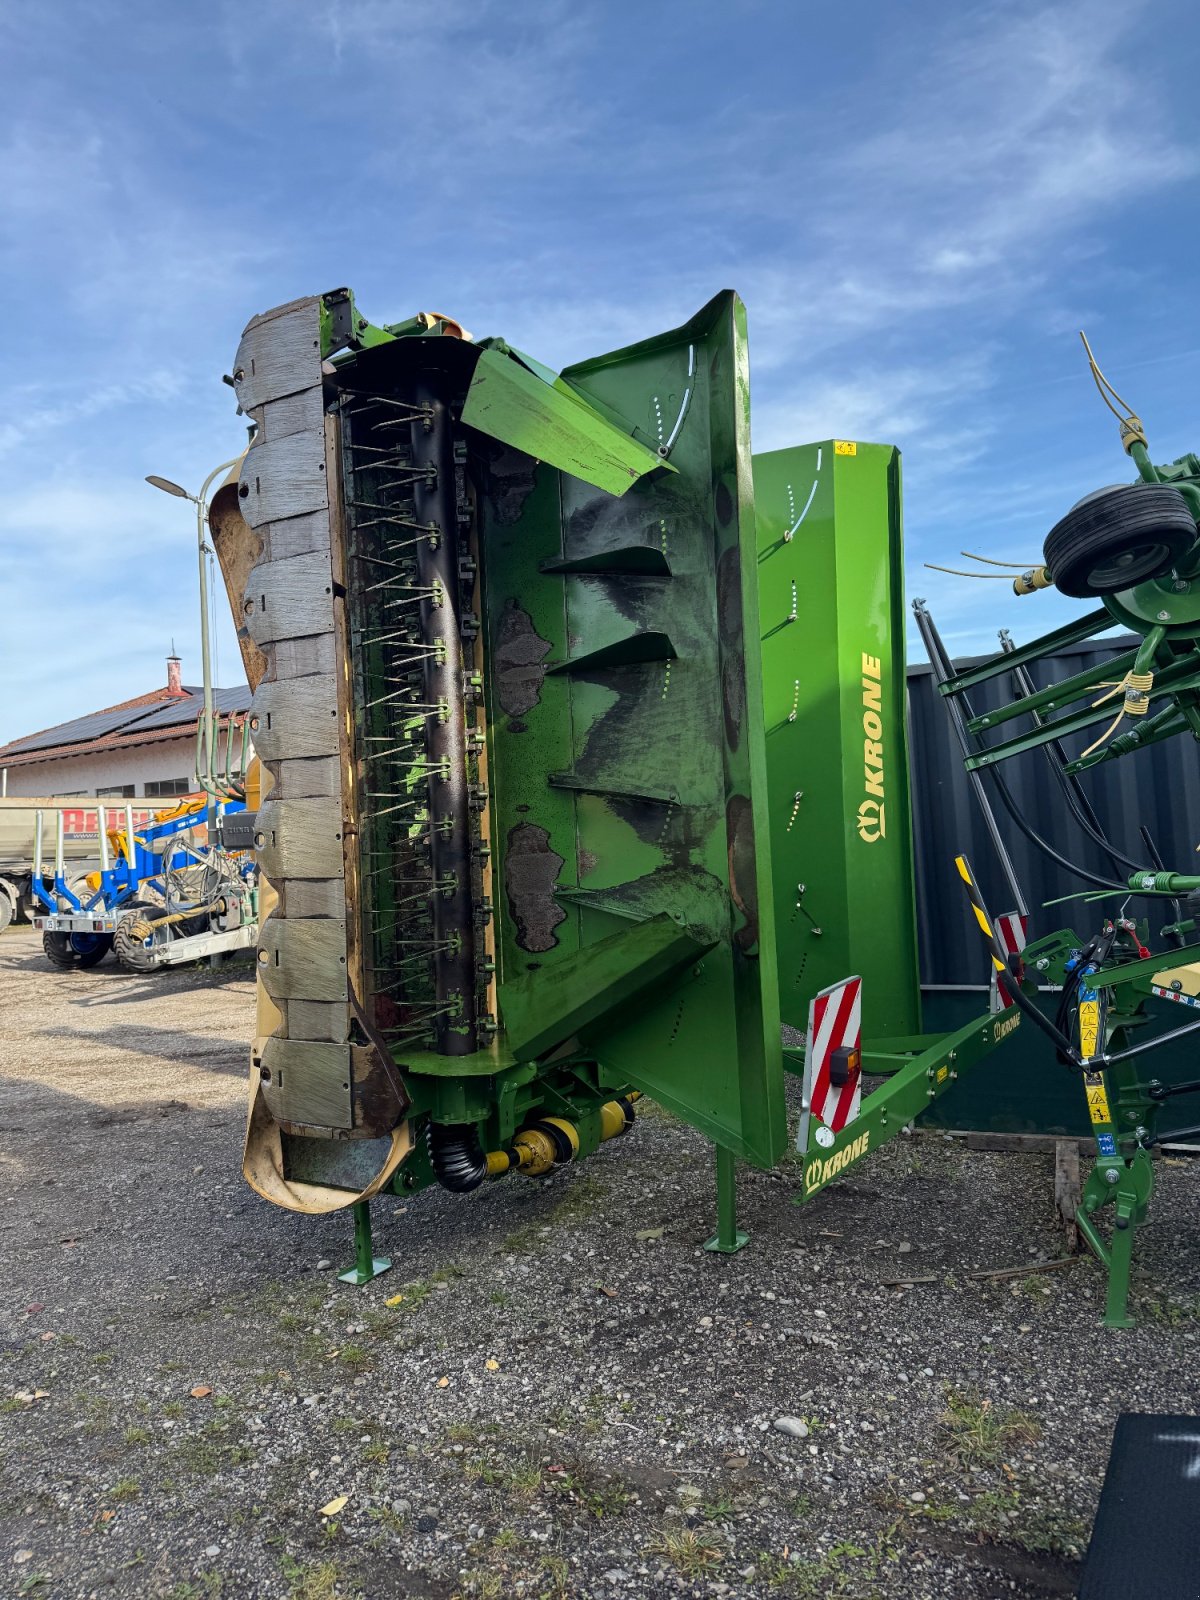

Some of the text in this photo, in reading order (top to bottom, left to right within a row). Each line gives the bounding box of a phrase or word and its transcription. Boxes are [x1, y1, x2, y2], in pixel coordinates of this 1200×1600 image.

[862, 652, 884, 798] KRONE
[1001, 1011, 1021, 1038] KRONE
[821, 1130, 870, 1184] KRONE
